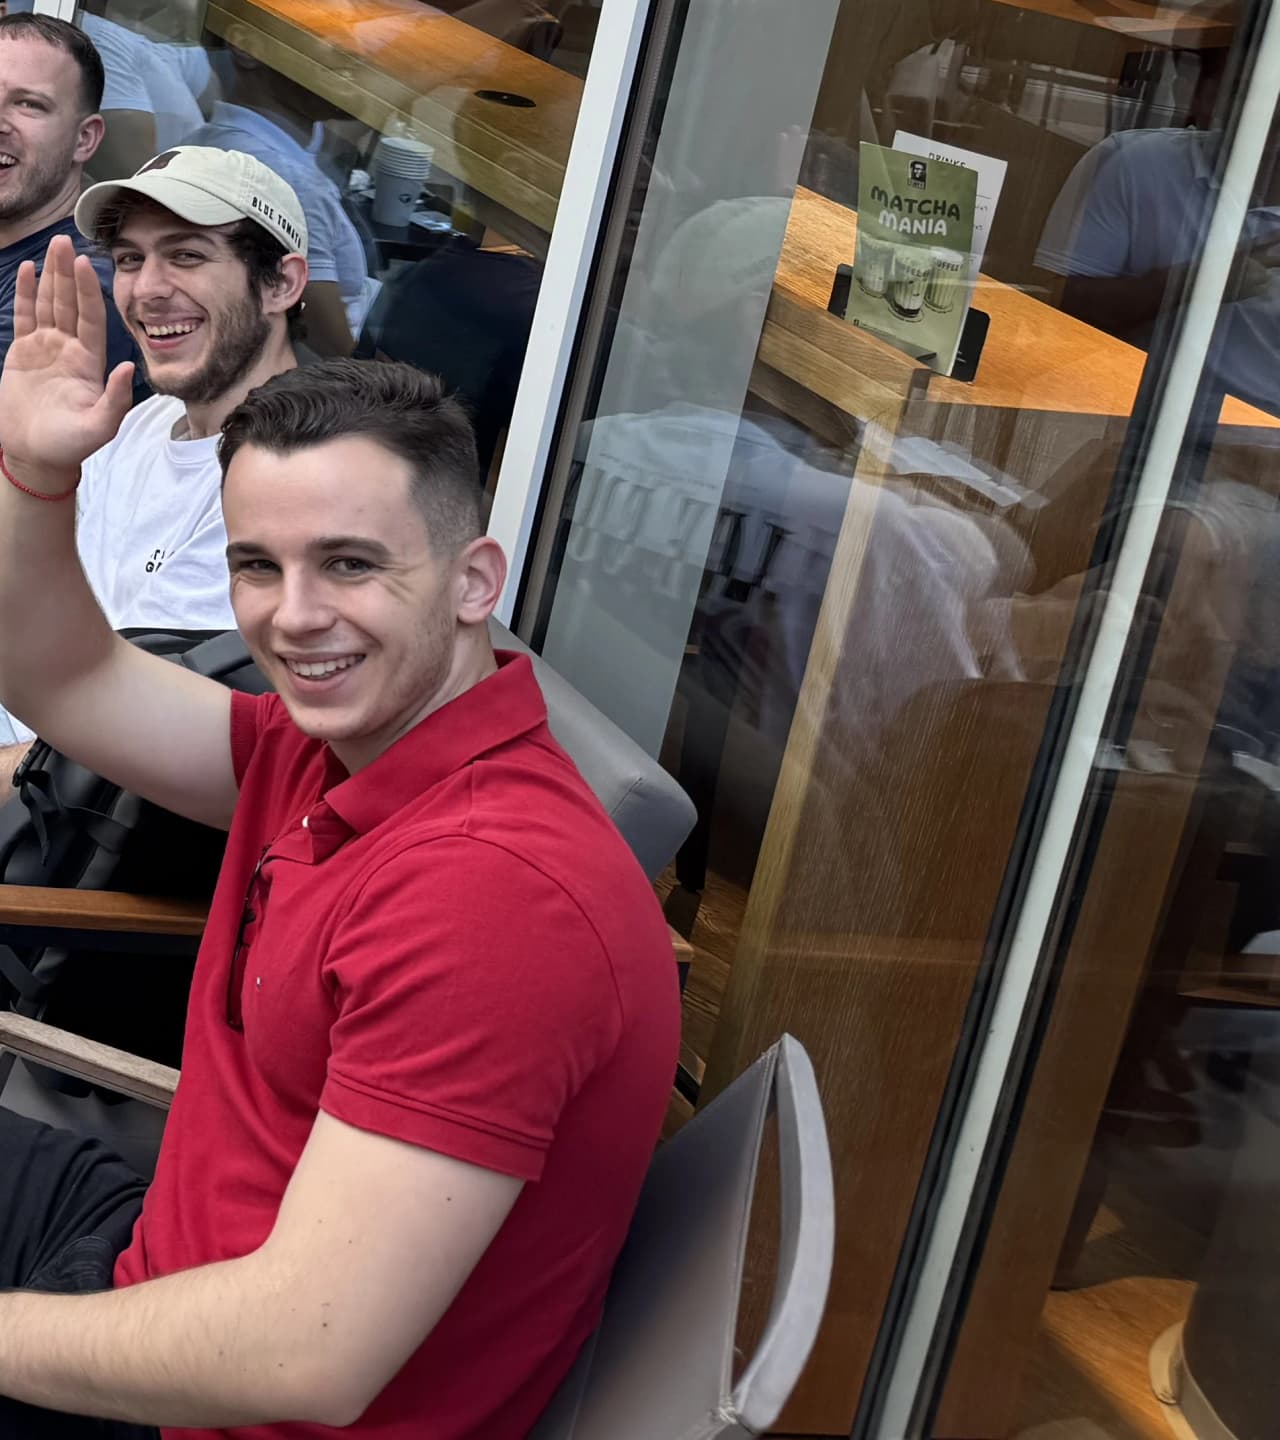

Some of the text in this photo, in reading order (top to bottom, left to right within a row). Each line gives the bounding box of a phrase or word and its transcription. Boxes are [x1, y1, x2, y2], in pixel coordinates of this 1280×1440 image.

[252, 196, 274, 220] BLUE
[870, 185, 961, 222] MATCHA
[878, 209, 948, 237] MANIA
